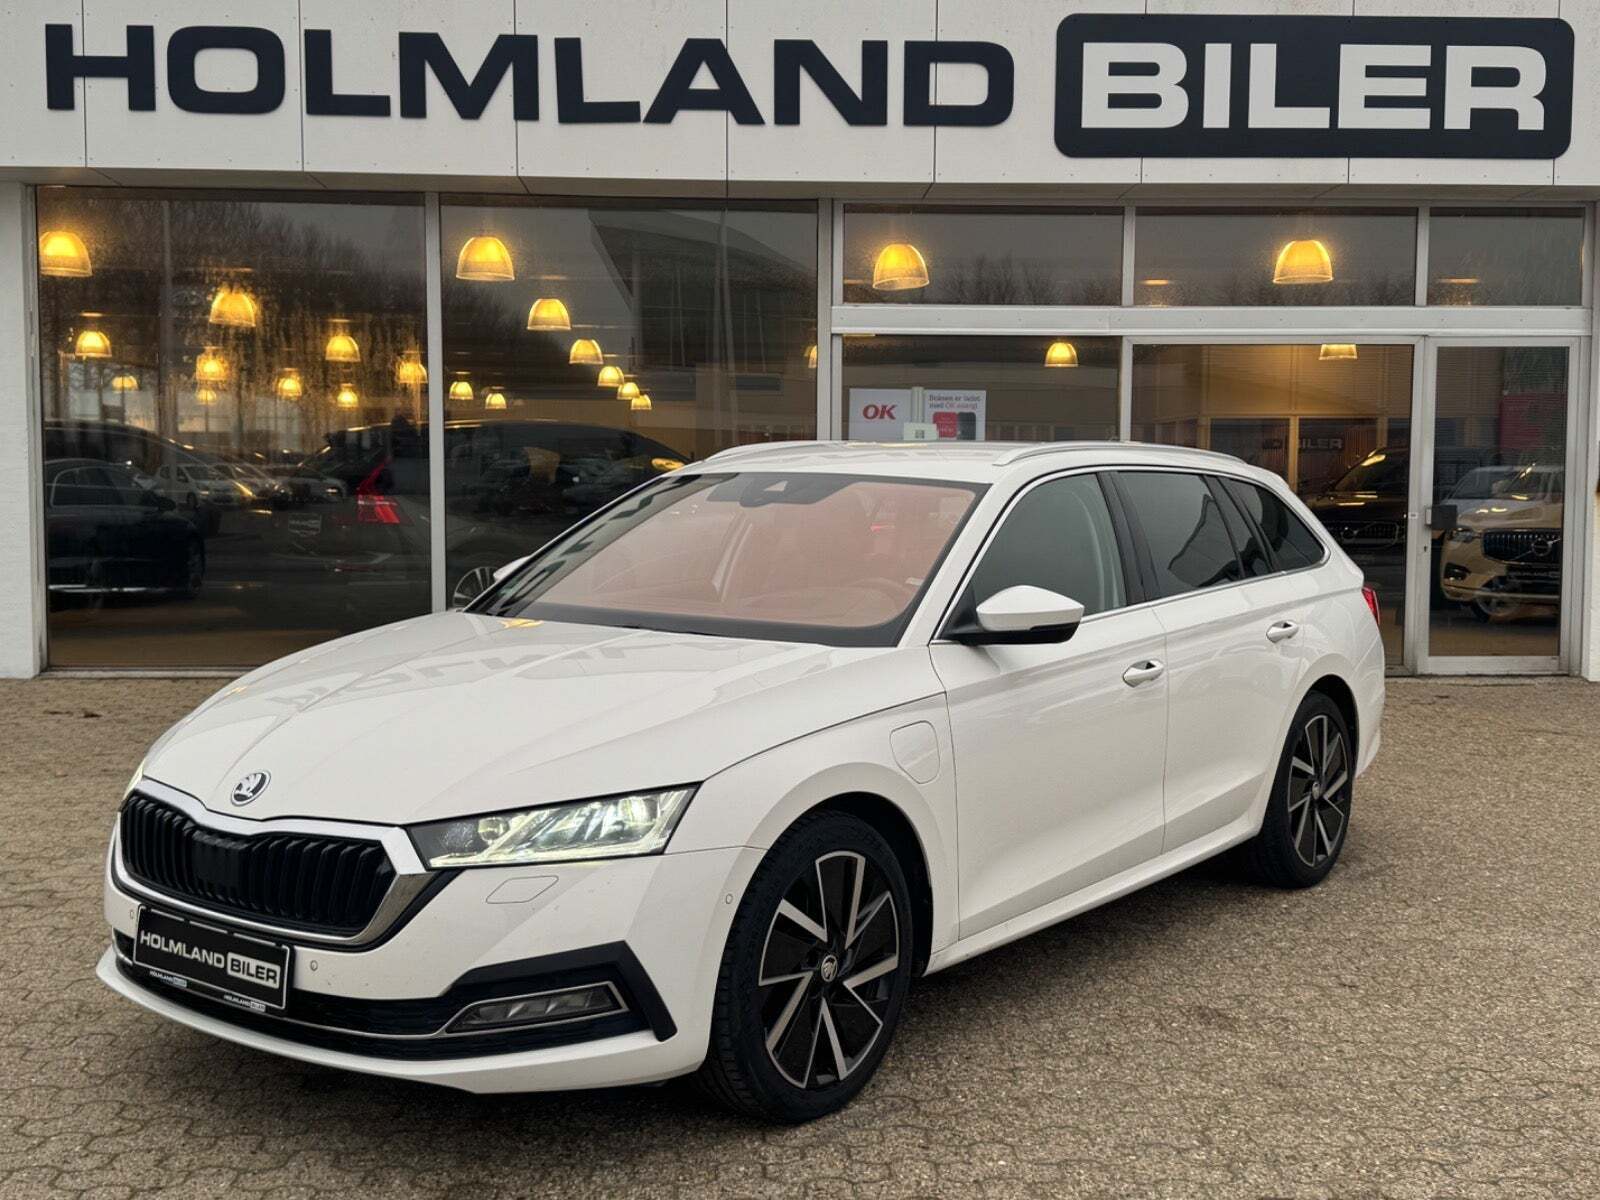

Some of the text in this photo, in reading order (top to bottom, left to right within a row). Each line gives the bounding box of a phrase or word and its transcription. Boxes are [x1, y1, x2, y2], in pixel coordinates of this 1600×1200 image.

[45, 24, 1547, 132] HOLMLAND BILER
[862, 403, 898, 420] OK
[1299, 437, 1343, 449] ILER
[140, 930, 278, 984] HOLMLAND BILER
